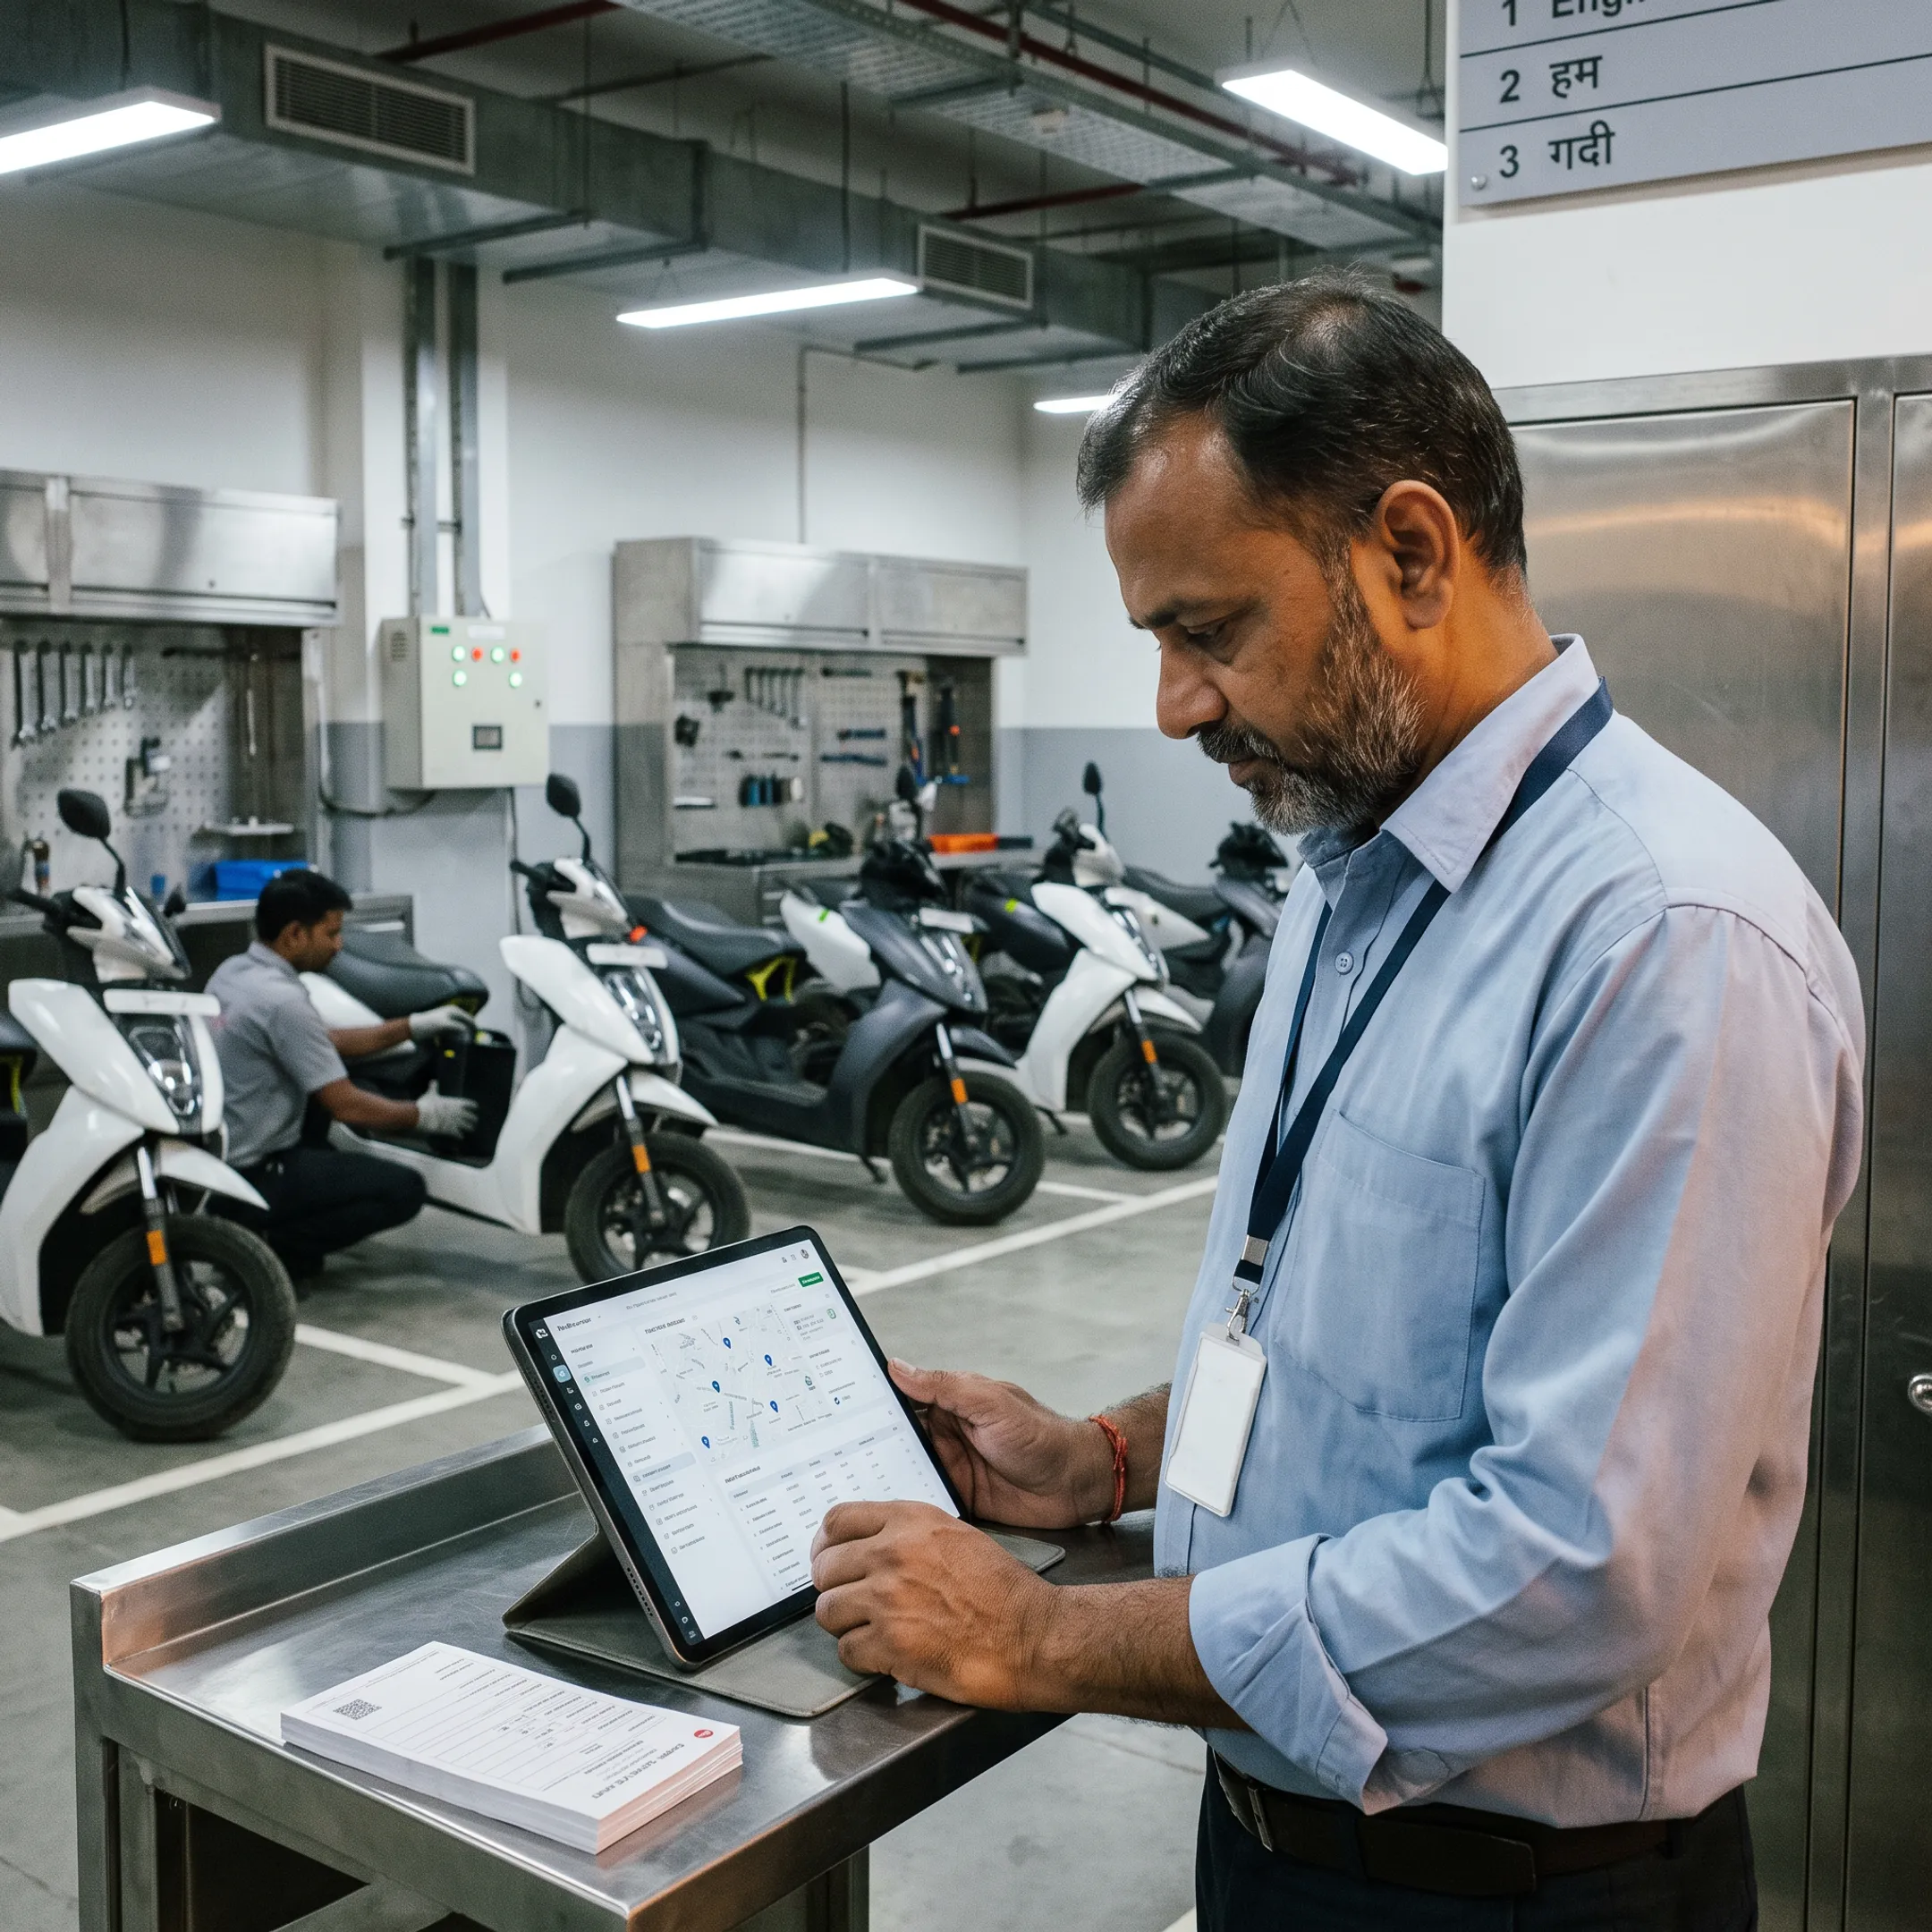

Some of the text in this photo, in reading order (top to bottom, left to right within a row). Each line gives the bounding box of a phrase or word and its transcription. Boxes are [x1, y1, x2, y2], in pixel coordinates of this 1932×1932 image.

[1502, 0, 1517, 27] 1
[1499, 55, 1604, 104] 2 हम
[1499, 119, 1616, 179] 3 गदी
